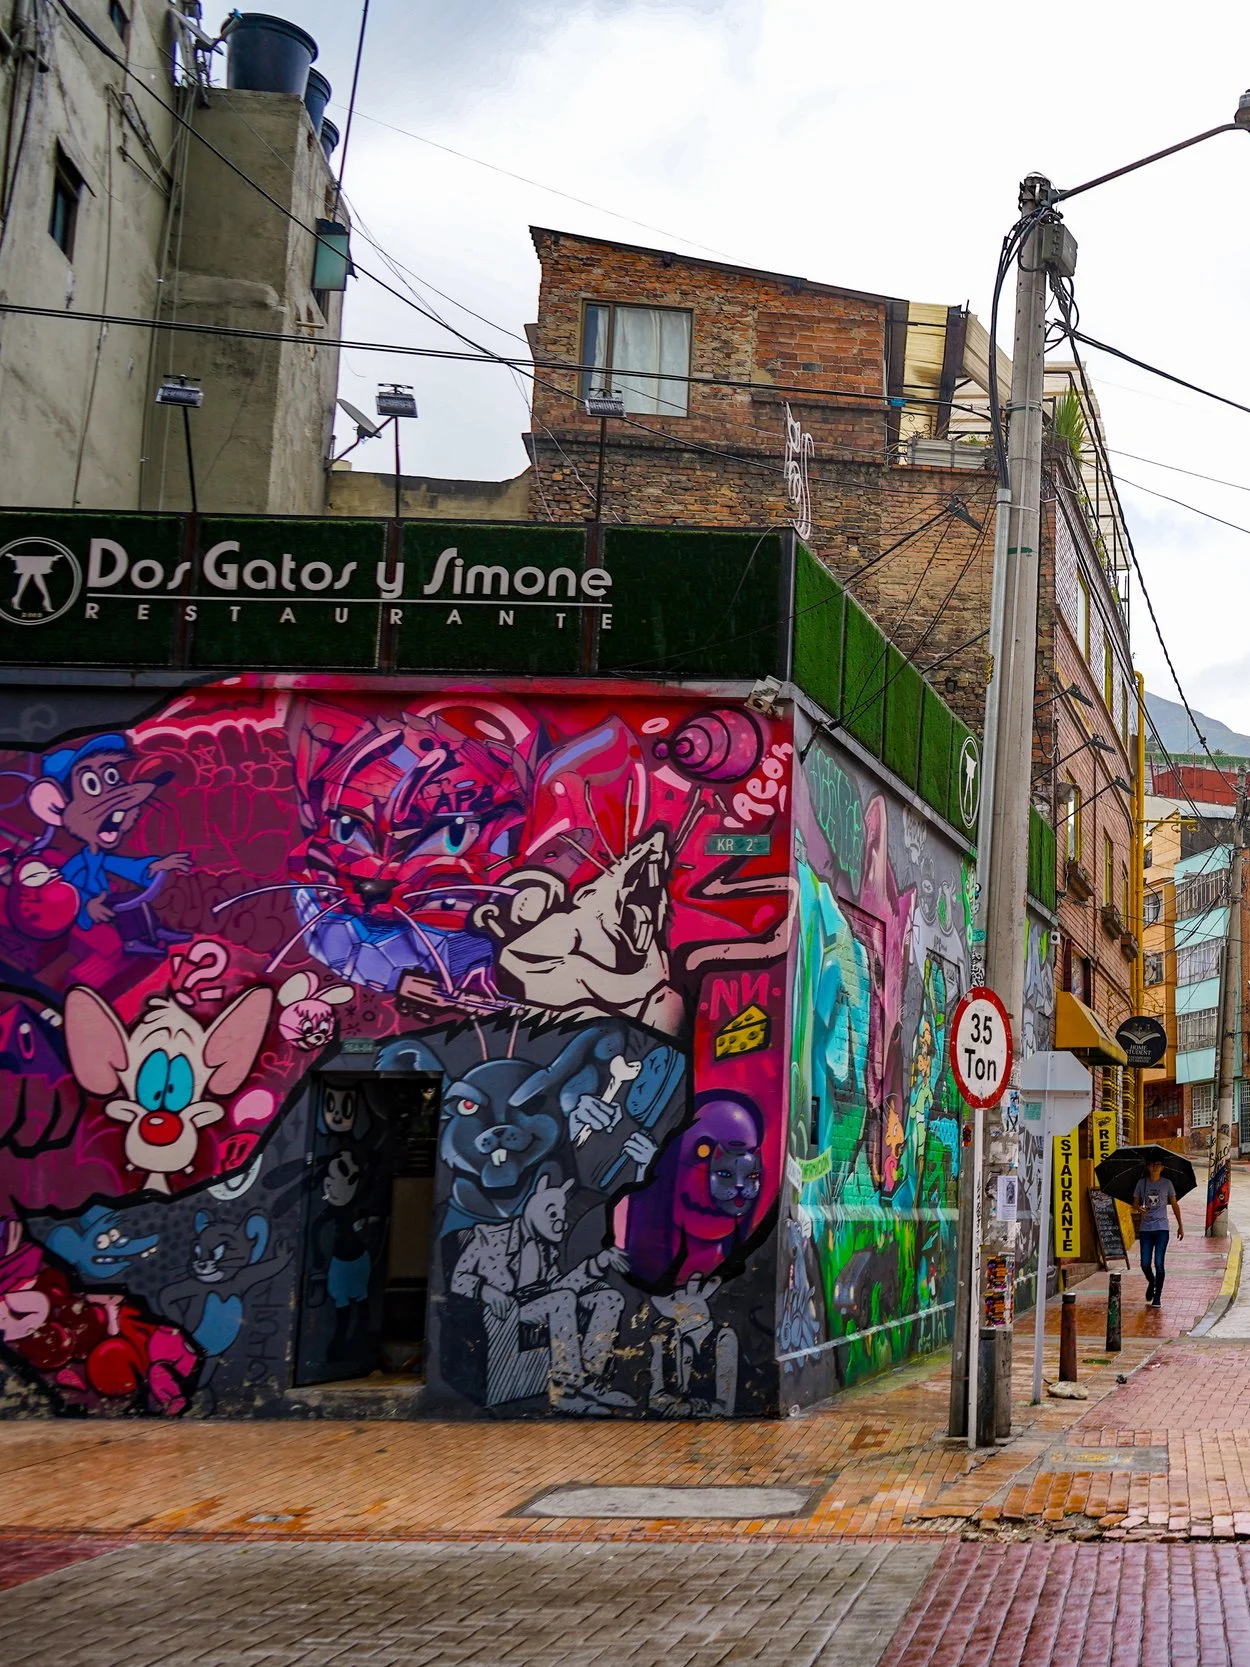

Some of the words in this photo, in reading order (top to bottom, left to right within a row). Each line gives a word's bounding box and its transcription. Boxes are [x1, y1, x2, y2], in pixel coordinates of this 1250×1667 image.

[87, 538, 191, 589] Dos
[203, 540, 358, 592] Gatos
[376, 561, 405, 599] y
[423, 547, 613, 597] Simone
[85, 602, 613, 630] RESTAURANTE
[717, 838, 735, 852] KR
[964, 1047, 997, 1082] Ton
[1060, 1134, 1073, 1252] STAURANTE
